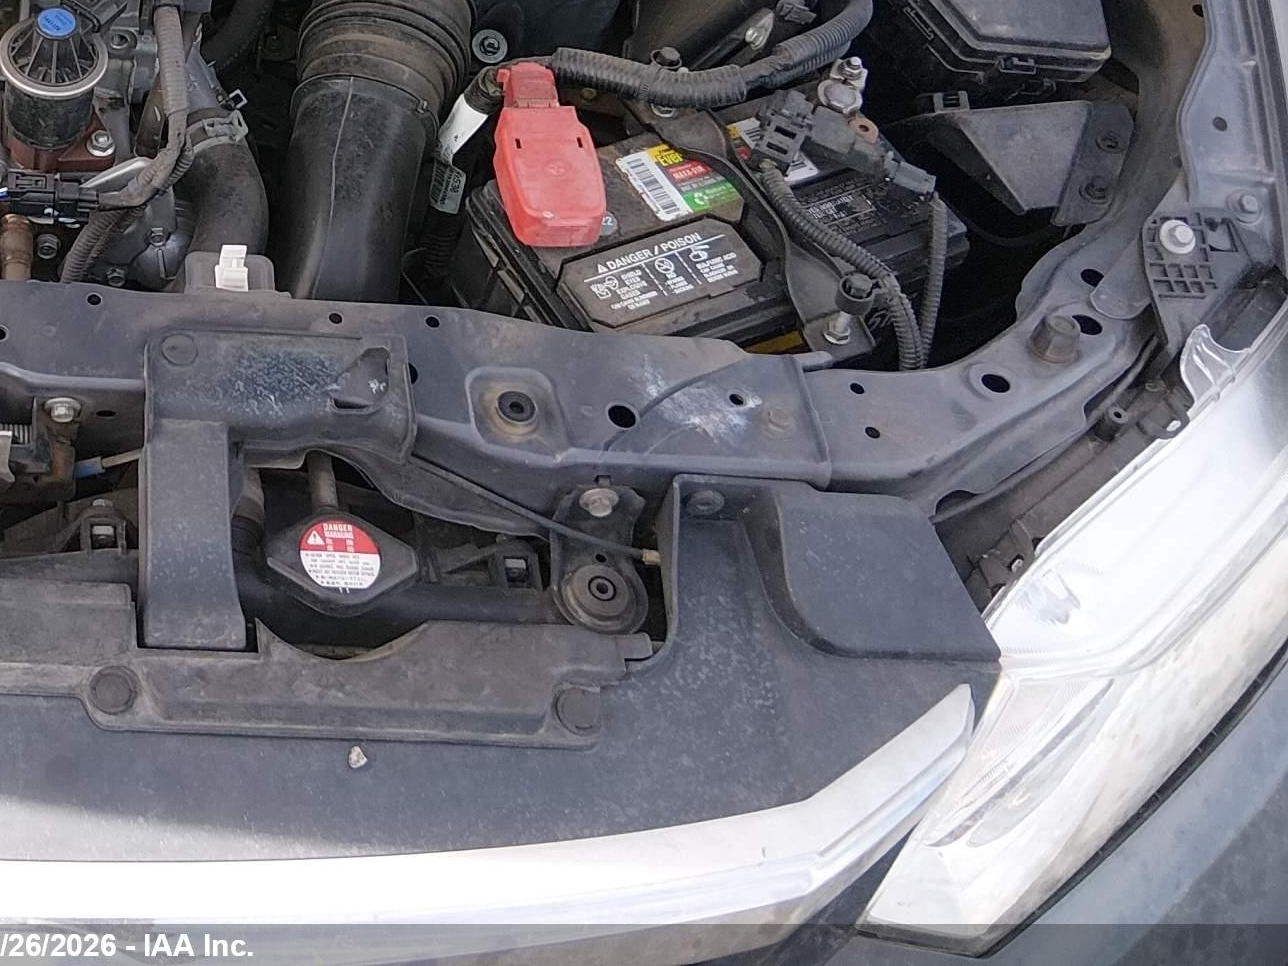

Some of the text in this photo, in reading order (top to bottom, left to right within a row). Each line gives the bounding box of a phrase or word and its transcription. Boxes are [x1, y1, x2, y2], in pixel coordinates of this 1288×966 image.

[605, 249, 653, 270] DANGER
[661, 232, 703, 252] POISON
[323, 523, 353, 532] DANGER
